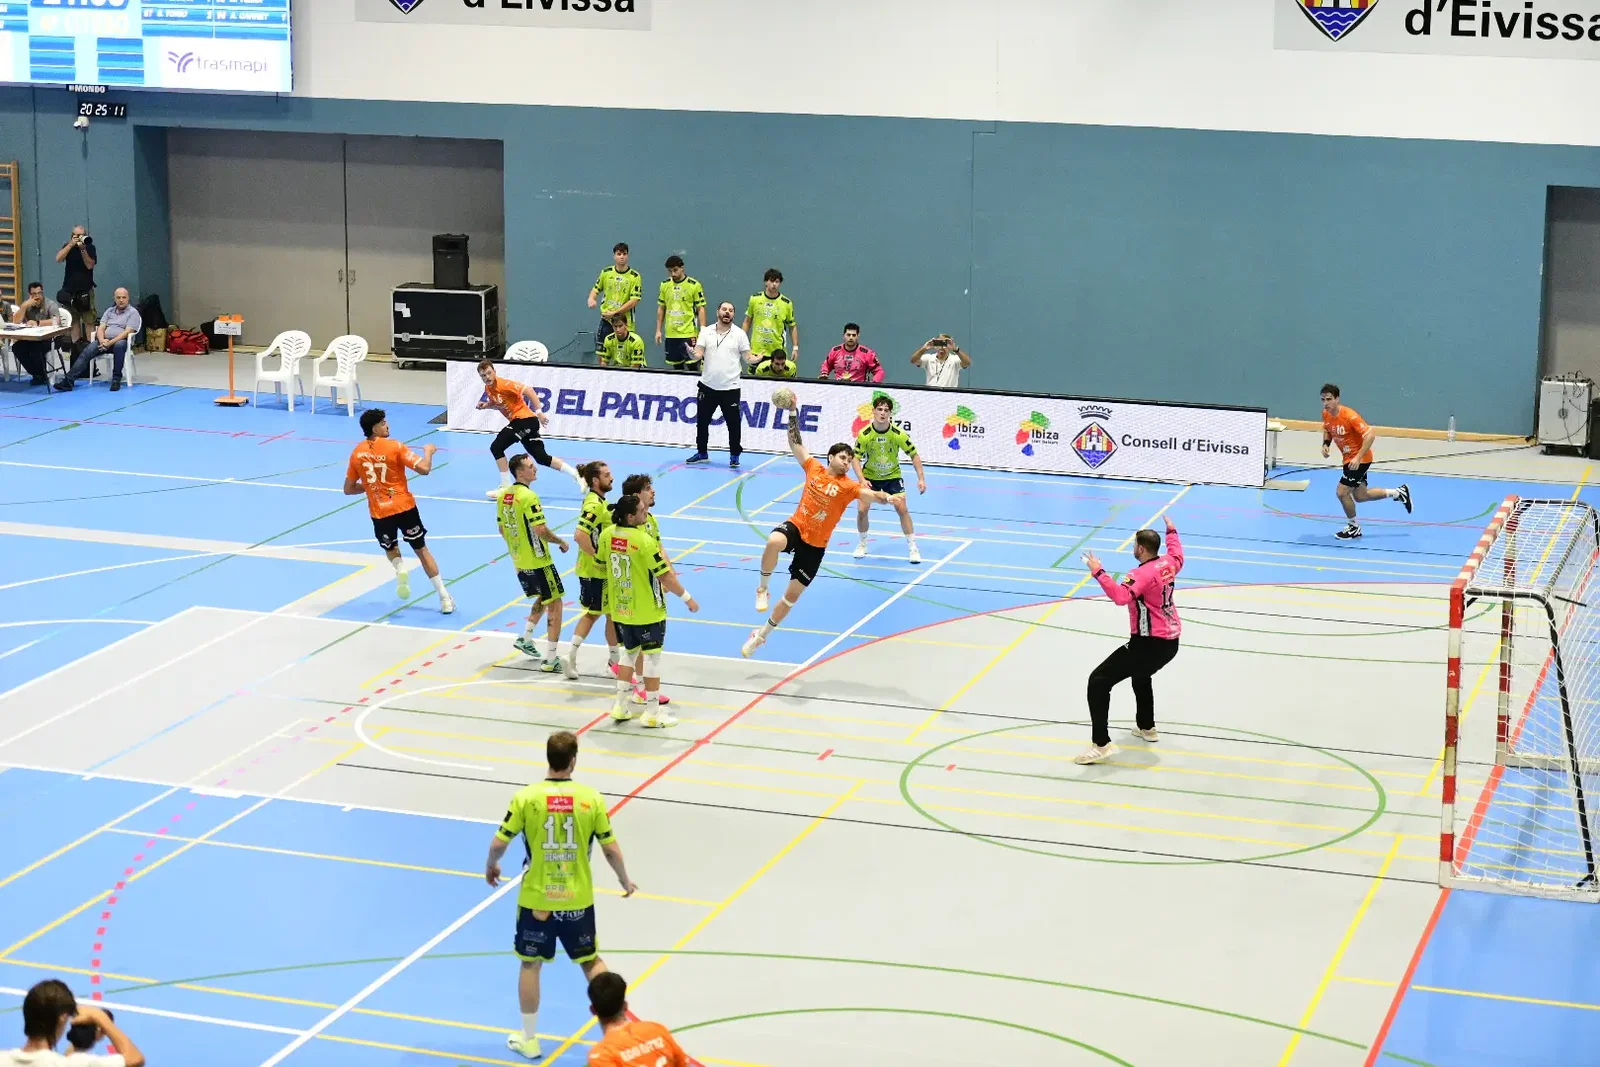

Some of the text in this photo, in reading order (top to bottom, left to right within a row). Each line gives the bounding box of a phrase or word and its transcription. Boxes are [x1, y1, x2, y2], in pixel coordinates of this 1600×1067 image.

[197, 56, 268, 74] trasmapi
[75, 84, 106, 94] MONDO
[80, 103, 93, 116] 20
[555, 388, 593, 417] EL
[598, 391, 770, 429] PATRONI
[772, 404, 823, 432] DE
[957, 423, 985, 434] Ibiza
[1031, 429, 1059, 440] Ibiza
[1336, 424, 1346, 435] 10
[1121, 433, 1250, 455] Consell d'Eivissa
[362, 461, 388, 484] 37
[825, 483, 839, 497] 18
[610, 553, 631, 579] 87
[541, 814, 579, 851] 11
